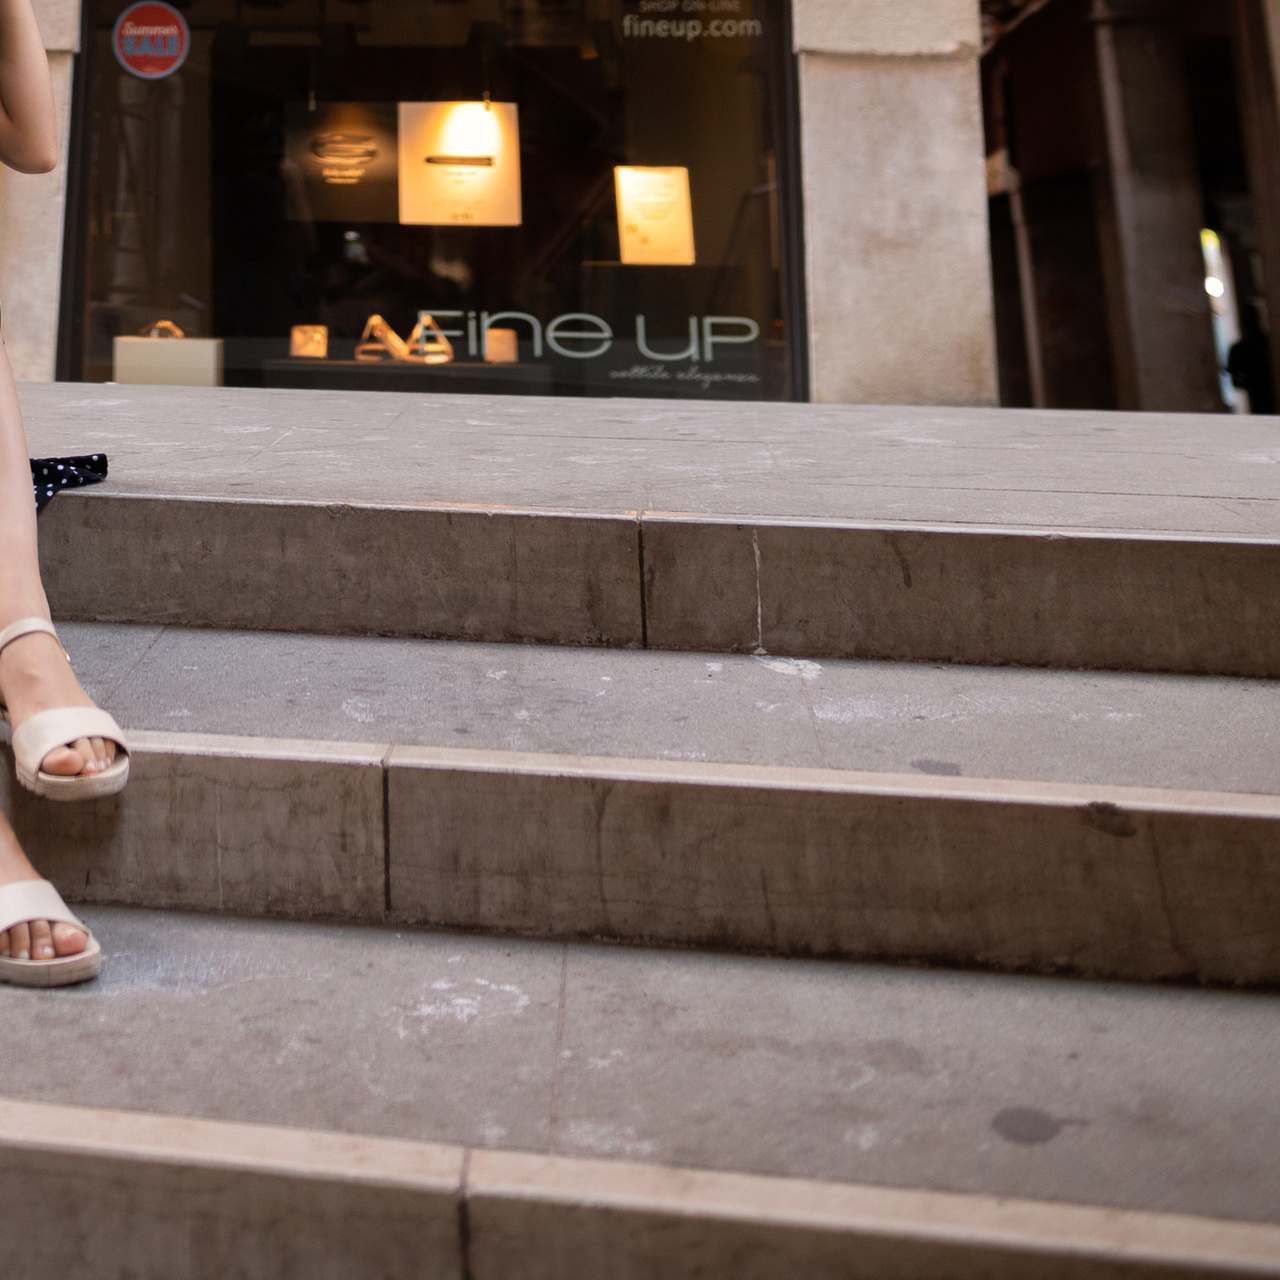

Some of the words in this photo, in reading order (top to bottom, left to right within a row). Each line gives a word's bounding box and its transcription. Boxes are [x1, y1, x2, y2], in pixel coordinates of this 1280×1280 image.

[122, 21, 178, 36] Summer
[622, 14, 762, 42] fineup.com
[123, 36, 179, 56] SALE
